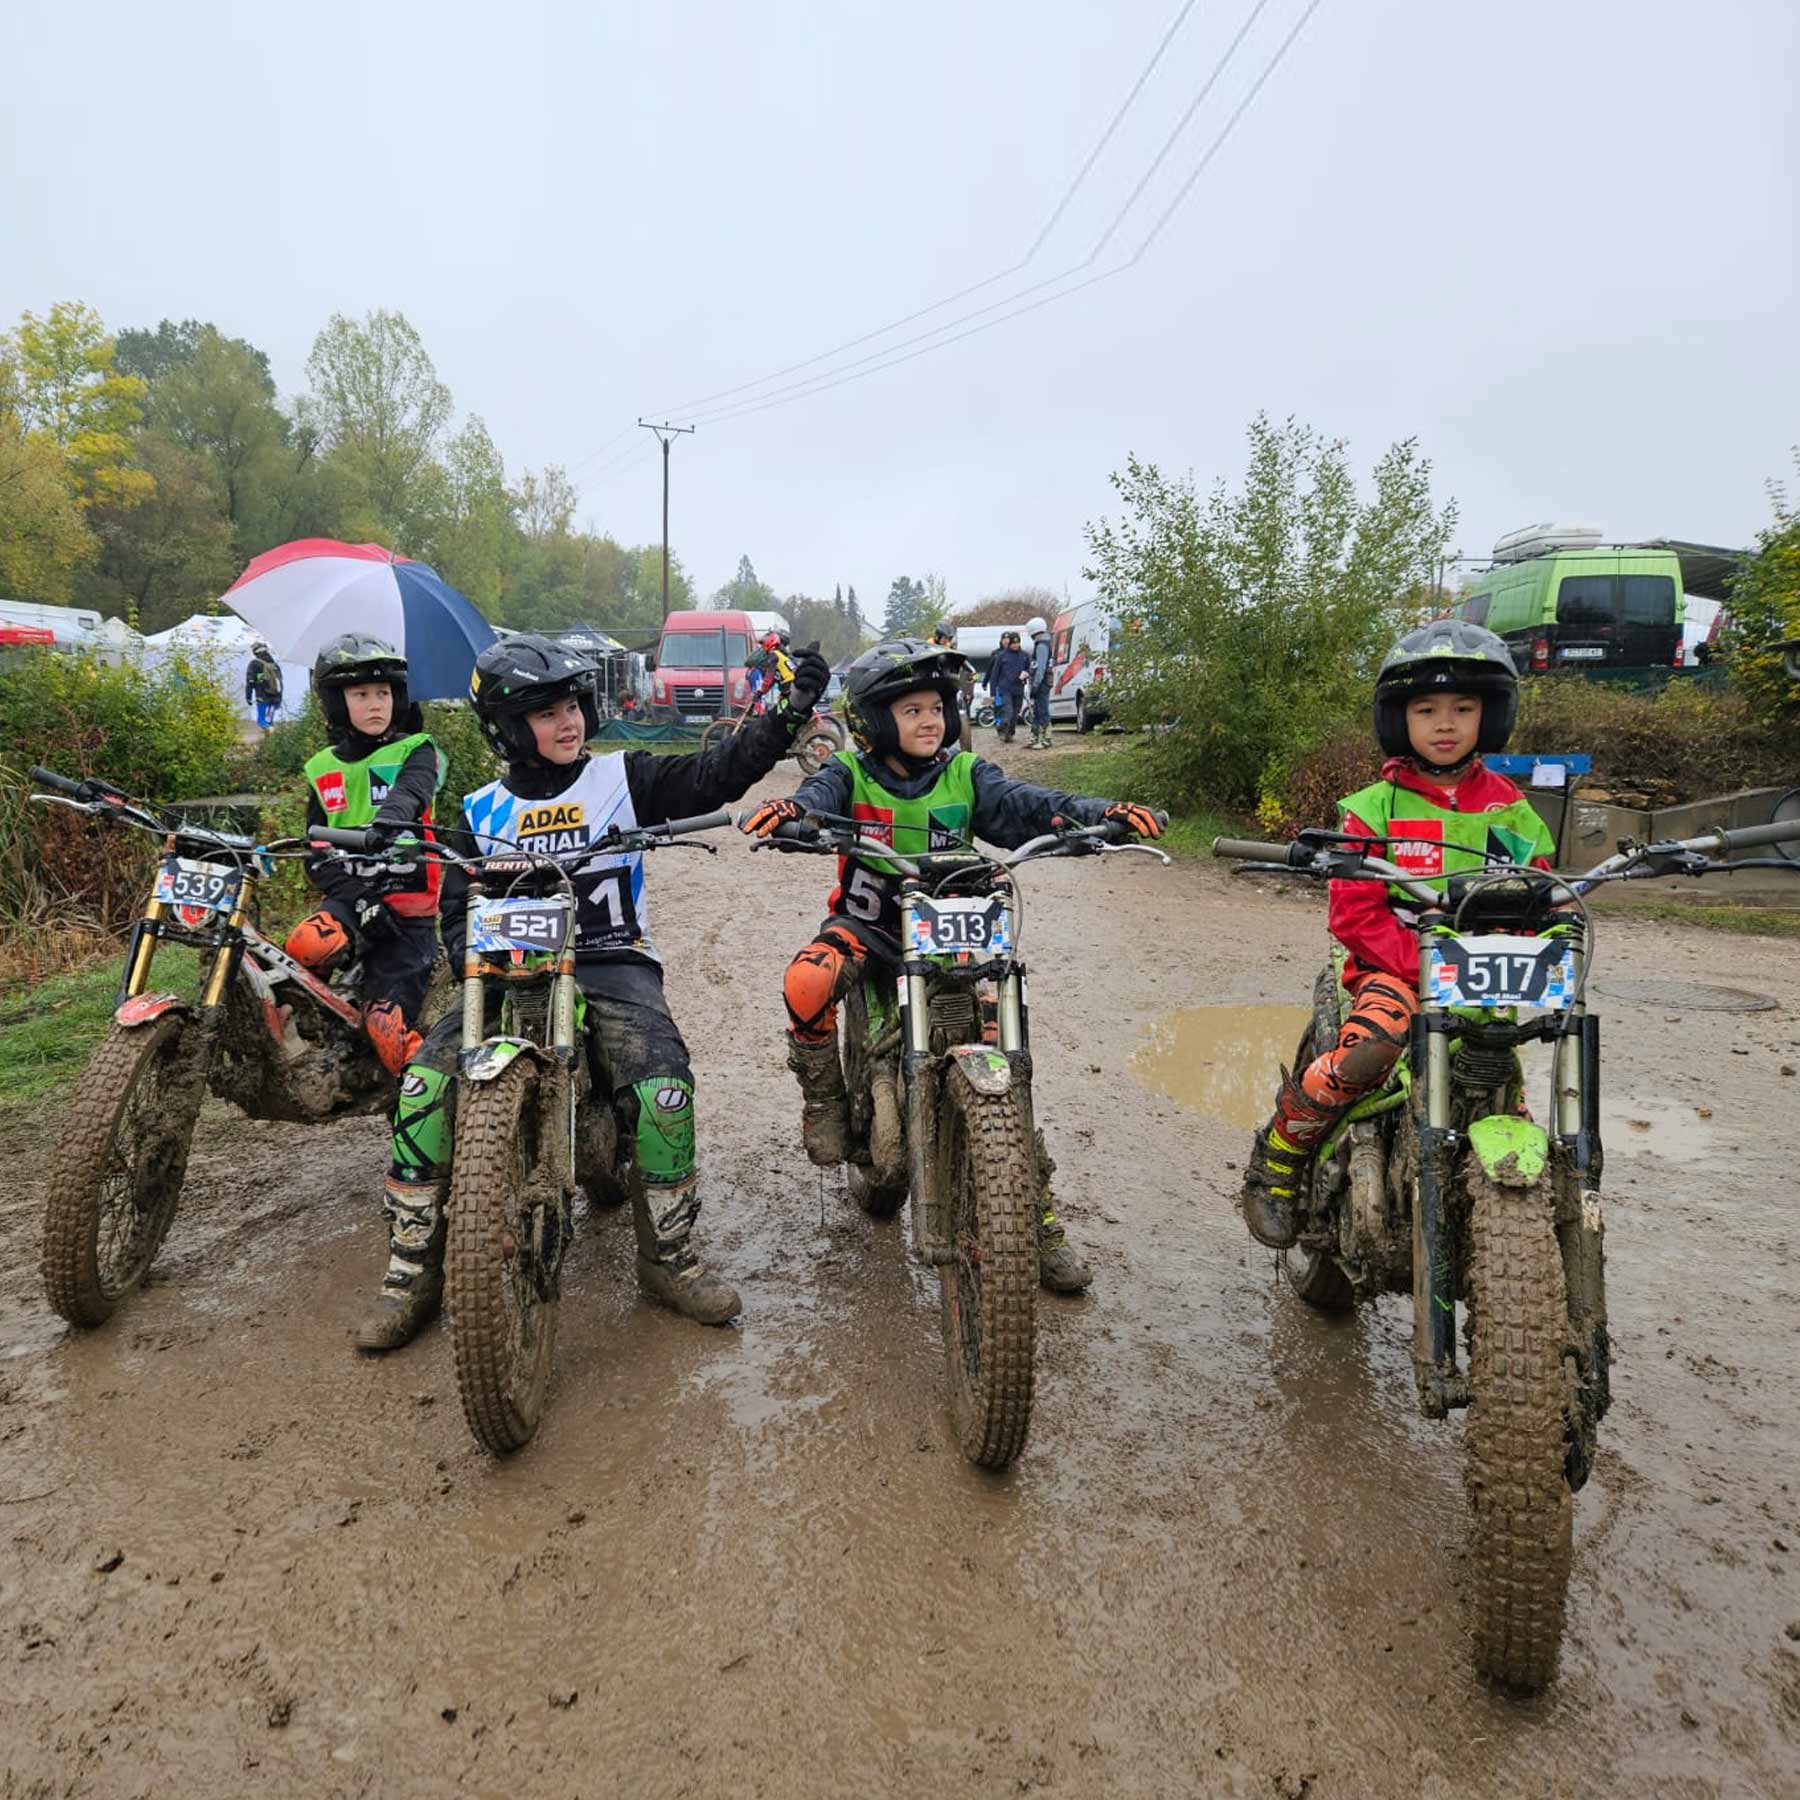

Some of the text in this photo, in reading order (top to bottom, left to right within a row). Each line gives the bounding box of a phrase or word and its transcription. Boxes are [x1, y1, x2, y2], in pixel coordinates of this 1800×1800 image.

[520, 806, 581, 832] ADAC
[518, 829, 587, 855] TRIAL
[174, 872, 225, 900] 539
[508, 914, 558, 939] 521
[937, 914, 987, 942] 513
[1467, 956, 1537, 992] 517
